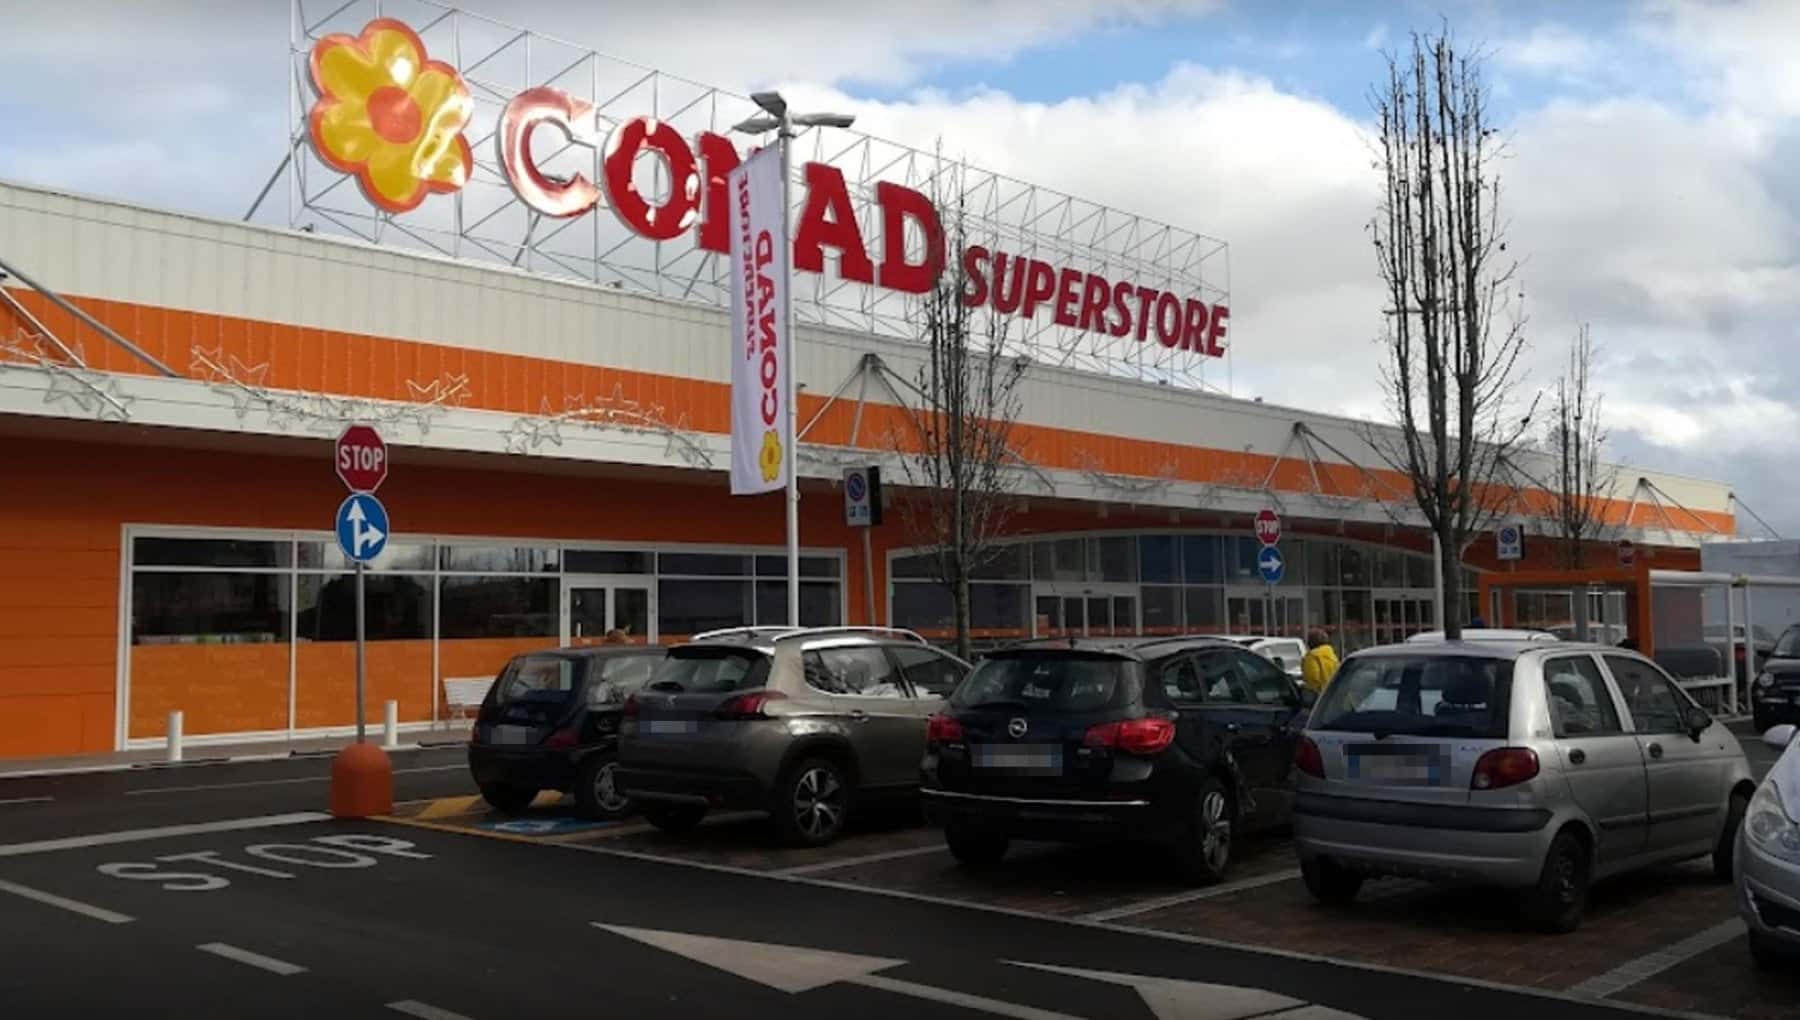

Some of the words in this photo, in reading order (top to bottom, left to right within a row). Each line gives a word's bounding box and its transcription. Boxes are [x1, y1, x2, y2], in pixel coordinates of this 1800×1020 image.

[961, 245, 1230, 359] SUPERSTORE
[340, 444, 384, 473] STOP
[96, 834, 433, 891] STOP
